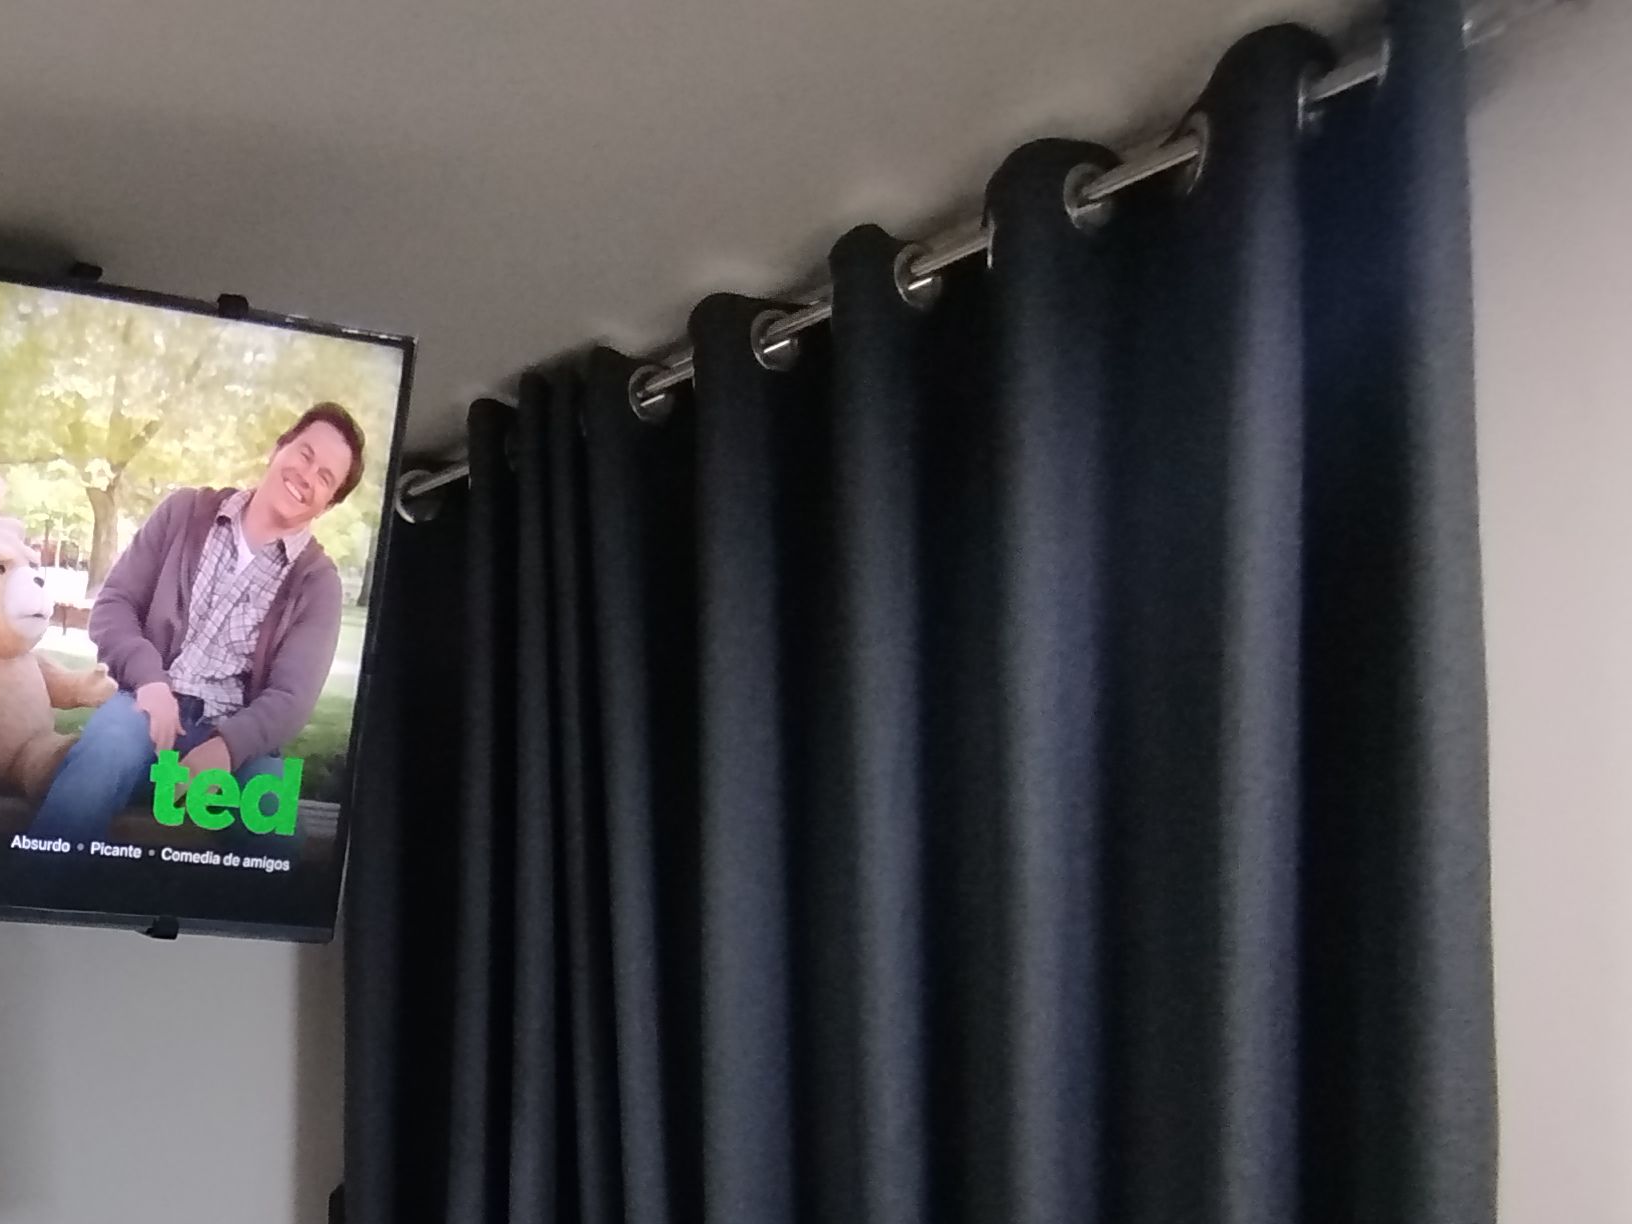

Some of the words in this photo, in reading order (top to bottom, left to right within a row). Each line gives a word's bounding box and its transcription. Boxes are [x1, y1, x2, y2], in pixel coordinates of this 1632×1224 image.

[150, 749, 304, 836] ted
[11, 834, 71, 853] Absurdo
[90, 841, 143, 859] Picante
[161, 847, 221, 866] Comedia
[223, 852, 241, 867] de
[242, 855, 291, 873] amigos
